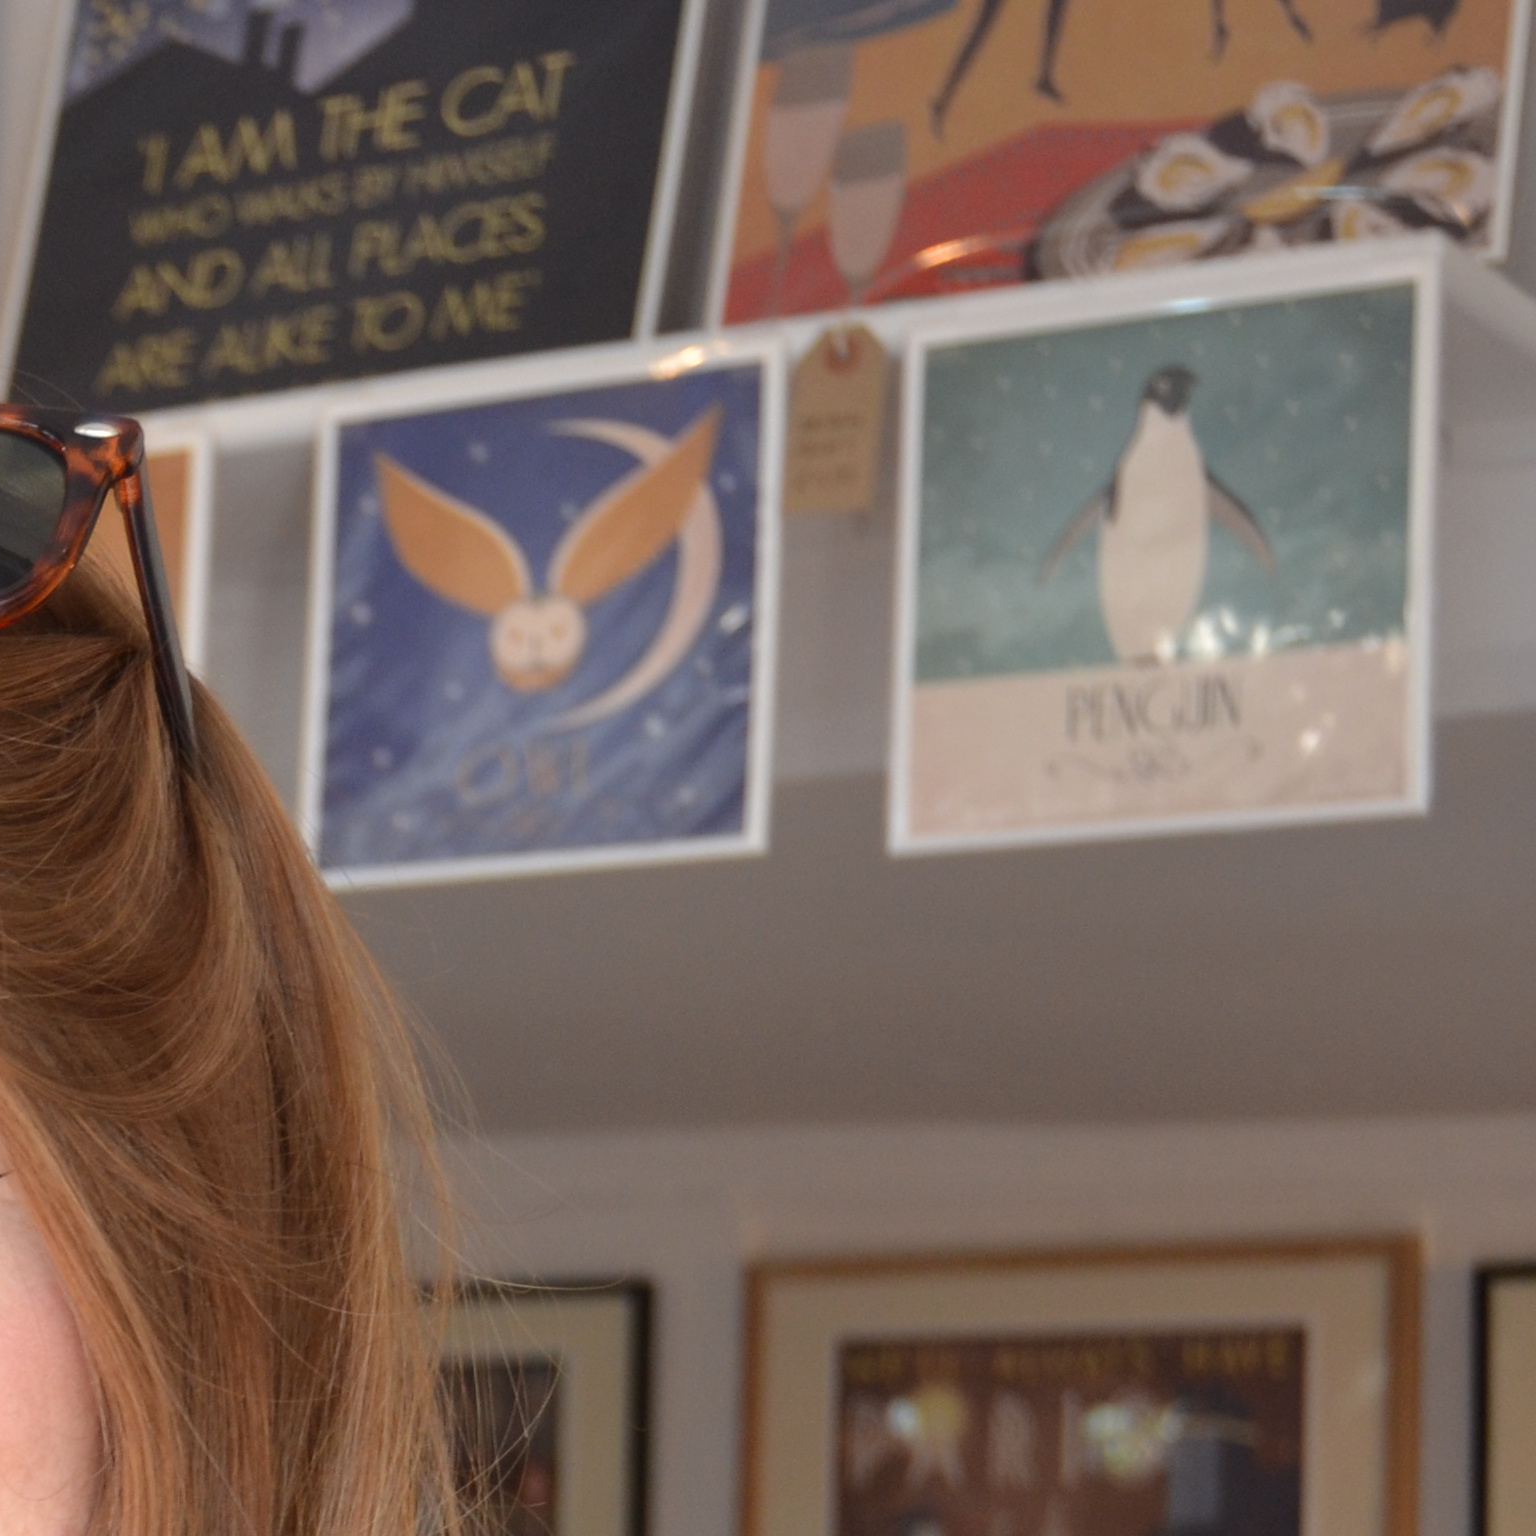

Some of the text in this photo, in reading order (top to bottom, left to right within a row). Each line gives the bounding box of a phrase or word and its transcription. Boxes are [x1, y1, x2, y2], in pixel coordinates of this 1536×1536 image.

[174, 106, 298, 192] AM
[317, 78, 428, 161] THE
[440, 49, 578, 138] CAT
[112, 191, 546, 323] AND ALL PLACES
[93, 325, 198, 396] ARE
[201, 303, 338, 382] ALIKE
[352, 290, 426, 354] TO
[1064, 672, 1242, 744] PENGUIN
